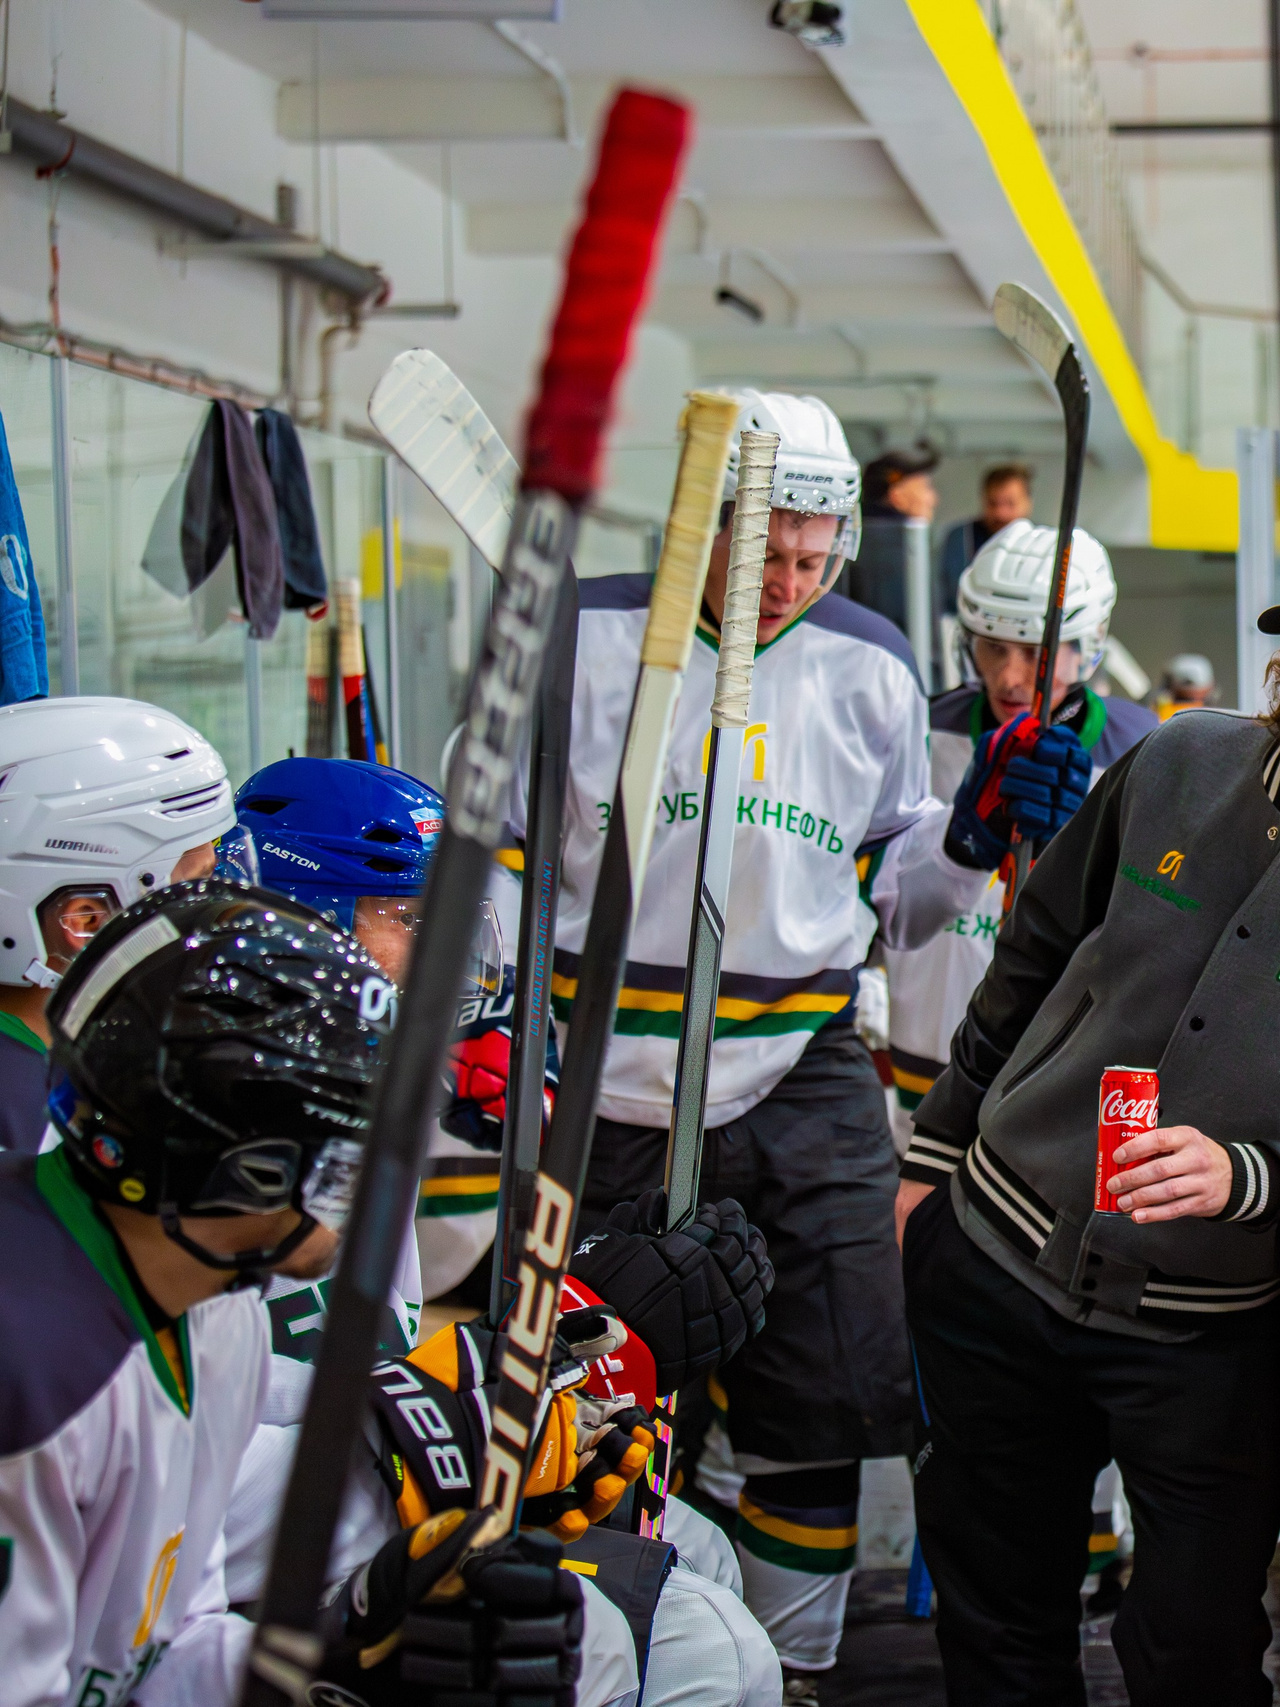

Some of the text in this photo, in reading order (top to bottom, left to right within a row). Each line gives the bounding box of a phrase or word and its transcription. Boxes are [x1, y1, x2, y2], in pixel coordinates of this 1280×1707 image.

[784, 472, 834, 484] BAUER
[262, 842, 320, 872] EASTON
[530, 859, 553, 1037] ULTRALOW KICKPOINT
